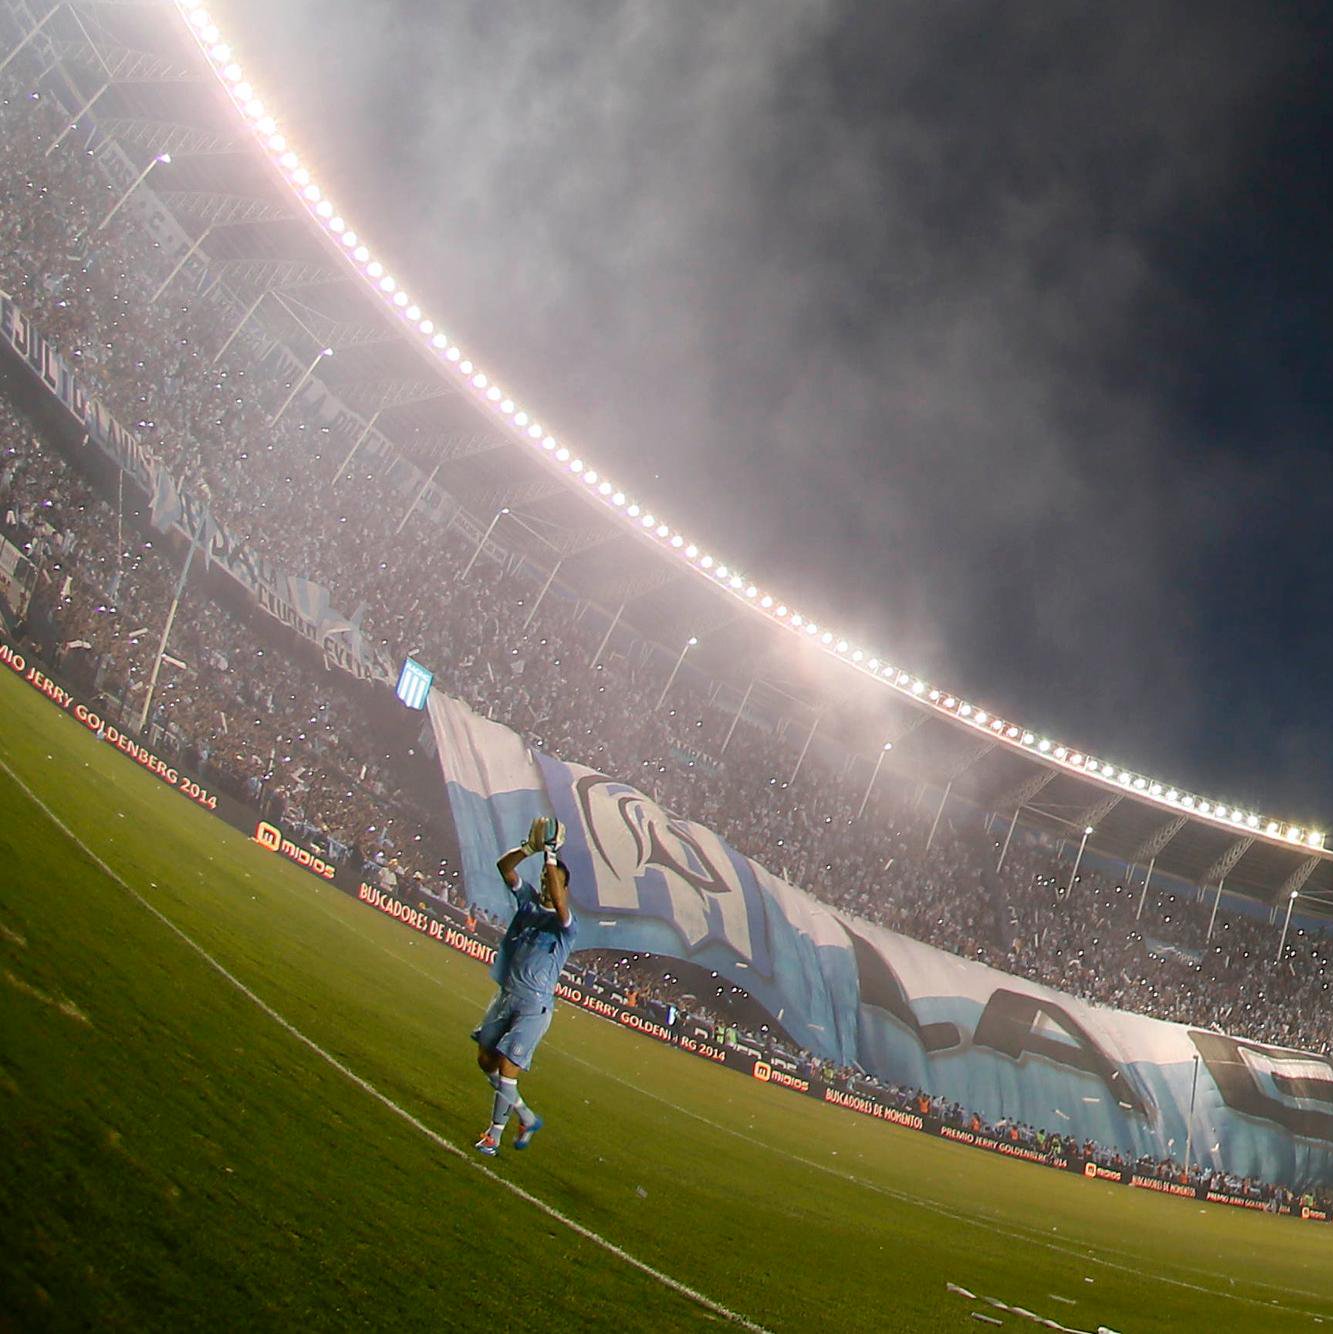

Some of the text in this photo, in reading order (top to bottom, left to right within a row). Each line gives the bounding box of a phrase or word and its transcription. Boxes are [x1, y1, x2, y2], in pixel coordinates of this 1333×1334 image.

[25, 667, 74, 708] JERRY
[73, 704, 178, 785] GOLDENBERG
[178, 777, 218, 810] 2014
[359, 882, 498, 967] BUSCADORES DE MOMENTO
[583, 995, 619, 1018] JERRY
[620, 1011, 699, 1051] GOLDENRG
[698, 1044, 727, 1063] 2014
[825, 1087, 924, 1131] BUSCADORES DE MOMENTOS
[939, 1125, 975, 1145] PREMIO
[974, 1135, 1000, 1151] JERRY
